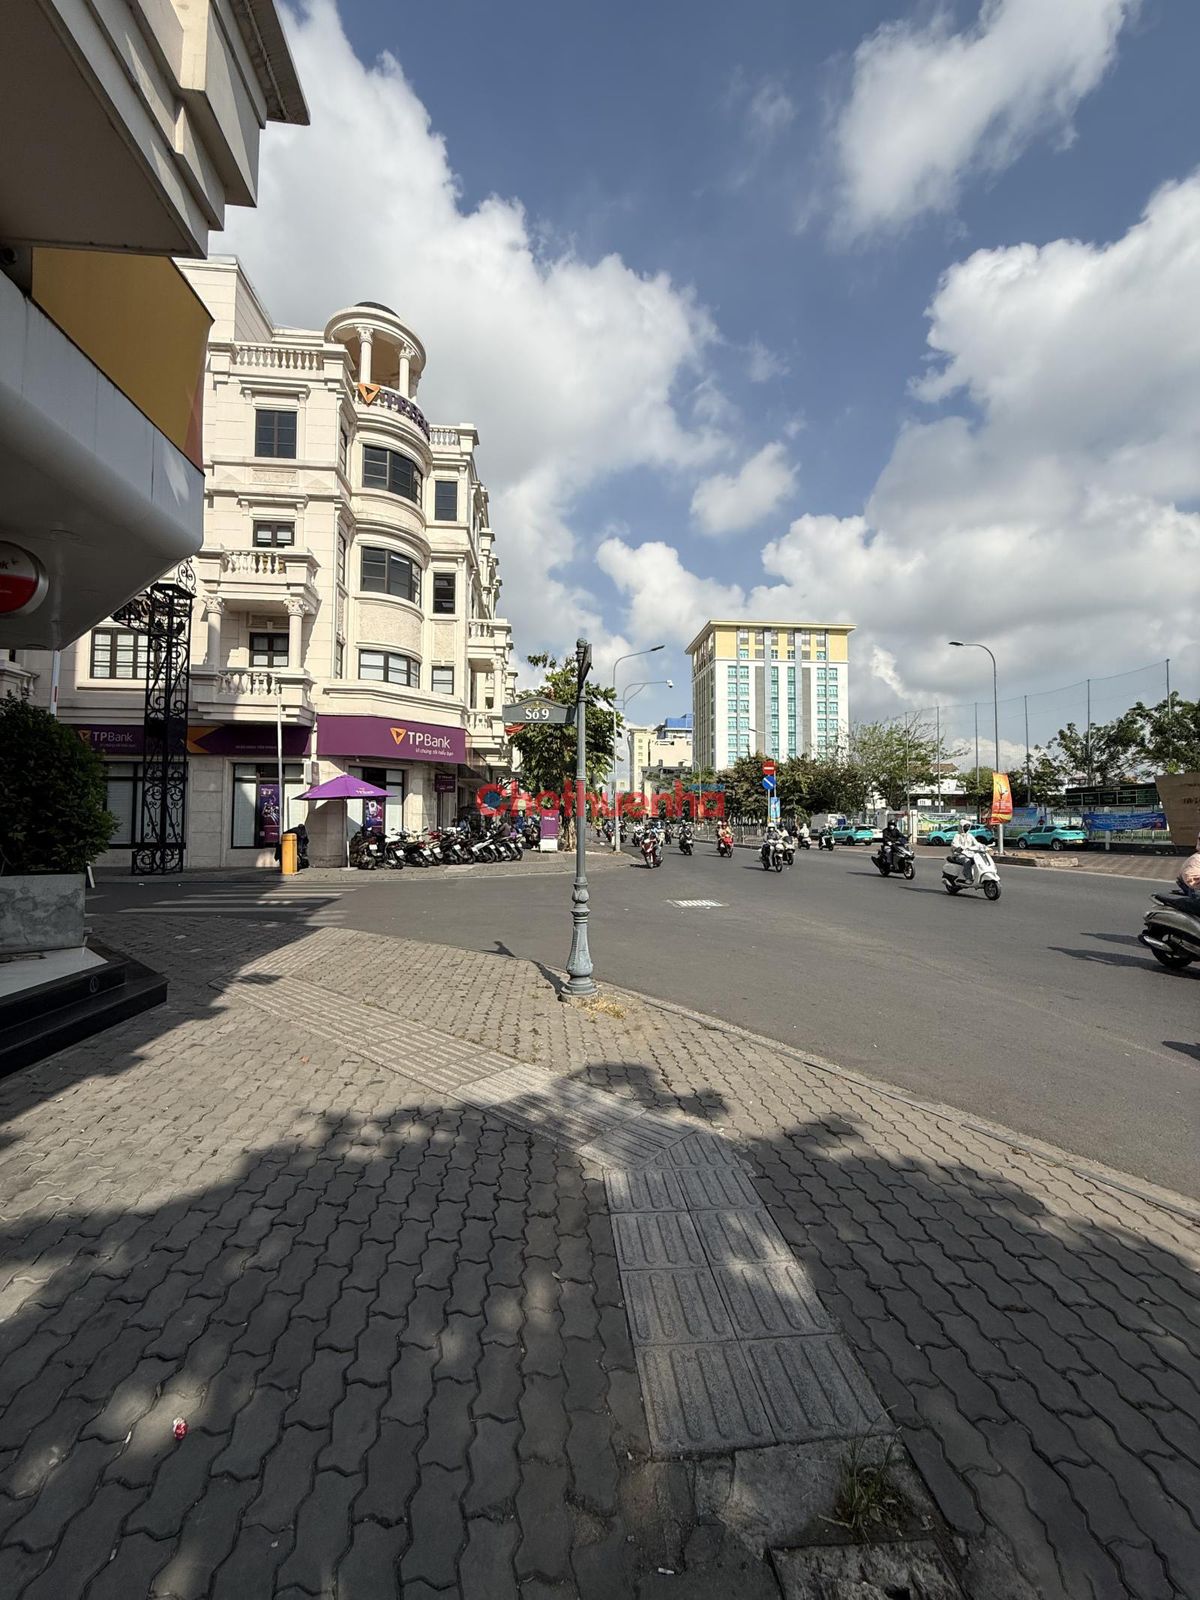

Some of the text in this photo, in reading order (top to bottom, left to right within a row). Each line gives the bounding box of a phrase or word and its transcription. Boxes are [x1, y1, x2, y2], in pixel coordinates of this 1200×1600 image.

[525, 707, 550, 720] Số 9
[93, 731, 134, 742] TPBank
[407, 731, 451, 749] TPBank
